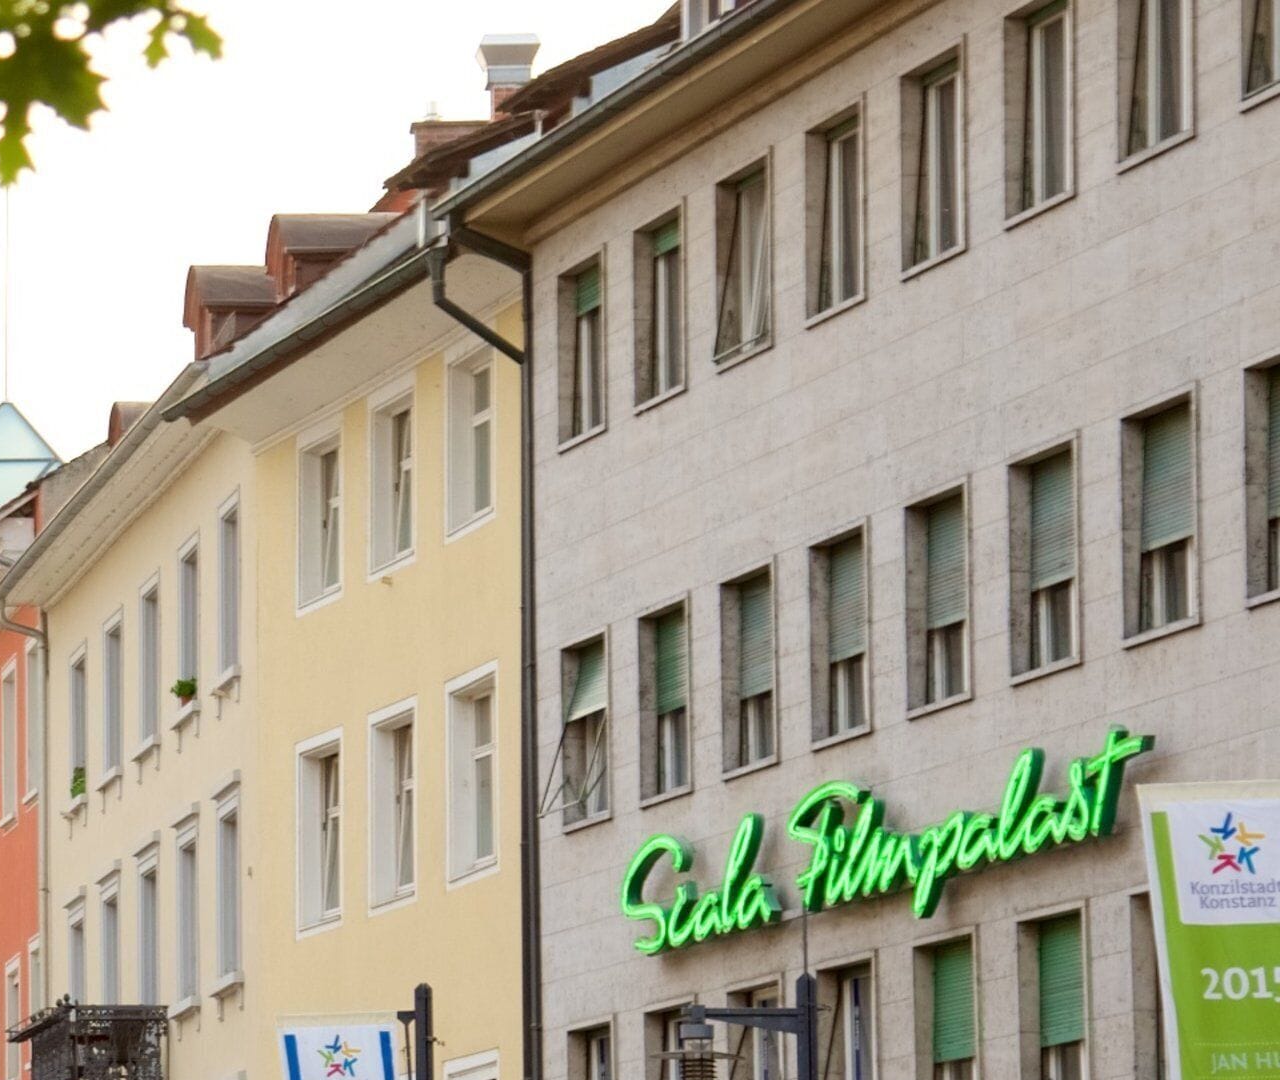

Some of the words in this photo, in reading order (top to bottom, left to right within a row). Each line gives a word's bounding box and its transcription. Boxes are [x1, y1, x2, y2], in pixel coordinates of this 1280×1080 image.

[620, 813, 783, 956] Scala
[787, 723, 1156, 919] Filmpalast
[1199, 894, 1278, 909] Konstanz
[1211, 1052, 1248, 1075] JAN
